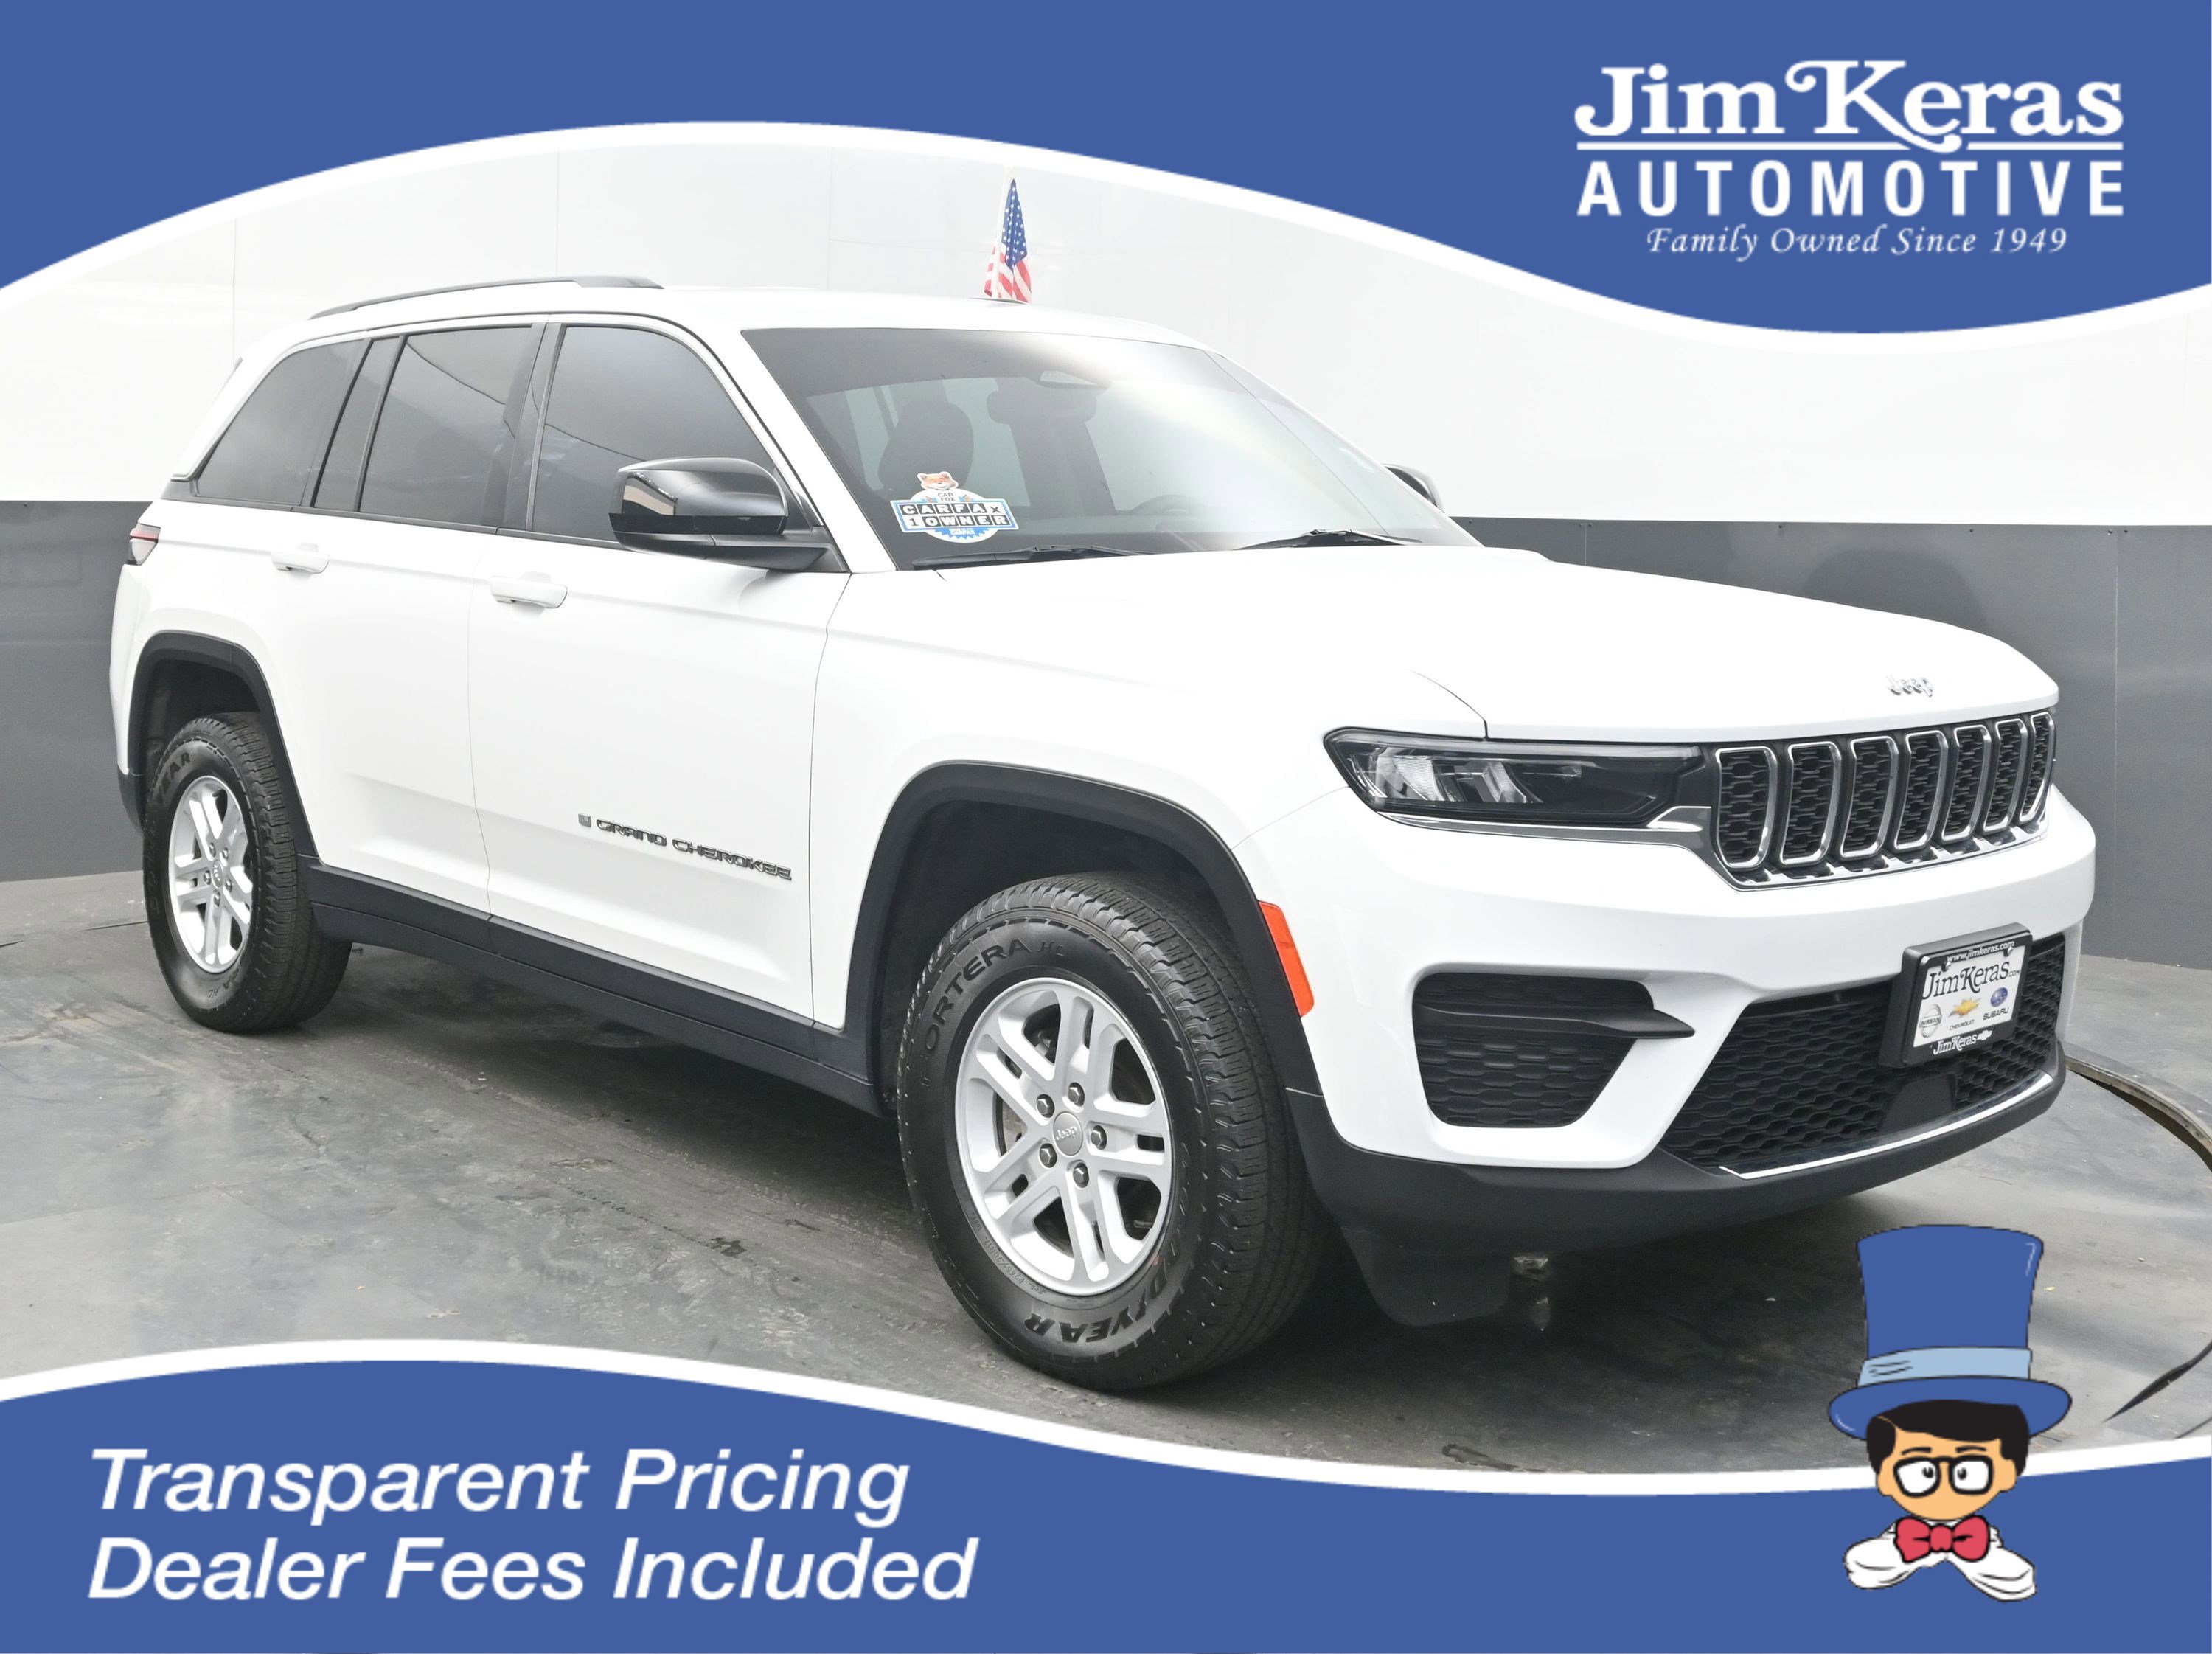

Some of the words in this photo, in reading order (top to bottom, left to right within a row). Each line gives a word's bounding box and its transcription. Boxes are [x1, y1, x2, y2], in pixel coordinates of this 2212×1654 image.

[923, 515, 1009, 527] OWNER
[1885, 673, 1933, 698] Jeep
[596, 818, 667, 847] GRAND
[672, 838, 793, 881] CHEROKEE
[1982, 1007, 2010, 1021] SUBARU
[1056, 1126, 1077, 1141] Jeep
